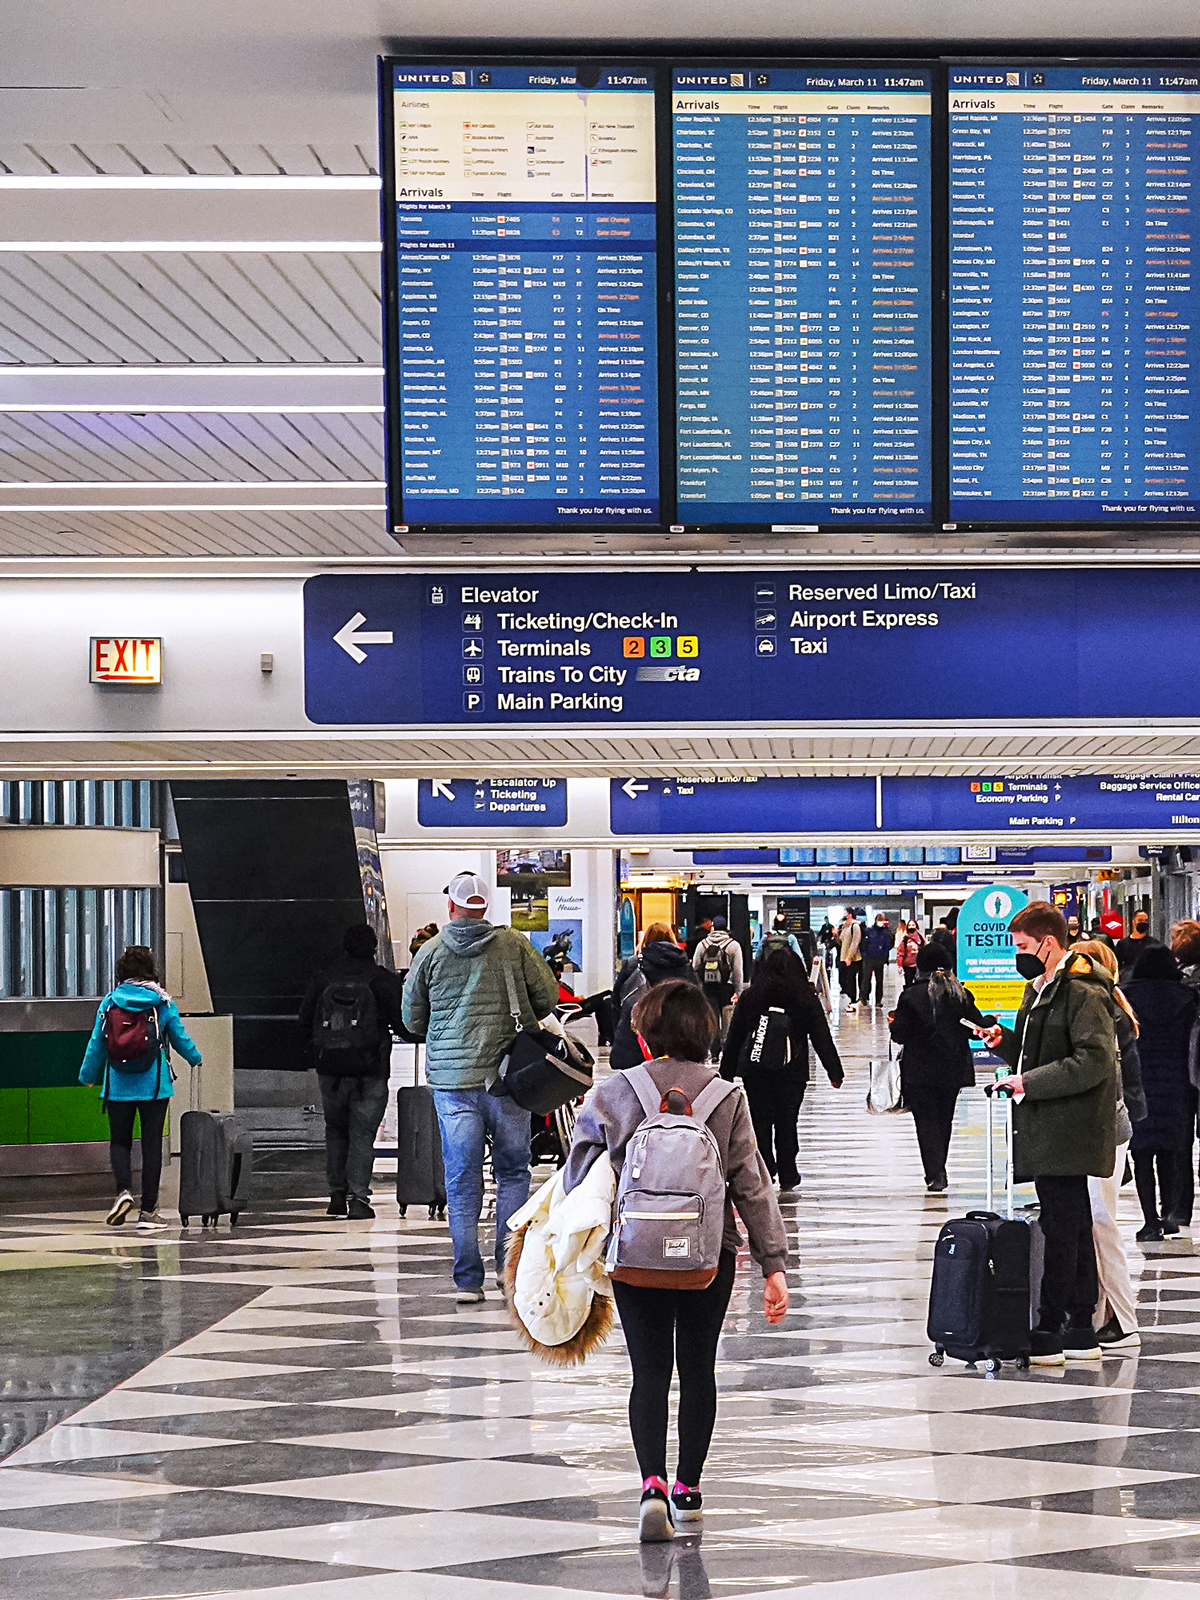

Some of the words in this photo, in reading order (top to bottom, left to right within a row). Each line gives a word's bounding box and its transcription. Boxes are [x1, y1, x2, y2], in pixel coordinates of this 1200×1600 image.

[529, 76, 559, 85] Friday,
[560, 76, 577, 84] Mar
[607, 76, 647, 85] 11:47am
[677, 76, 728, 84] UNITED
[806, 78, 836, 87] Friday,
[837, 78, 864, 86] March
[867, 78, 877, 86] 11
[884, 78, 924, 87] 11:47am
[953, 75, 1004, 84] UNITED
[1081, 77, 1111, 86] Friday,
[1112, 77, 1139, 85] March
[1142, 77, 1151, 85] 11
[1158, 77, 1198, 86] 11:47am
[676, 100, 720, 110] Arrivals
[952, 99, 996, 109] Arrivals
[399, 188, 444, 198] Arrivals
[557, 506, 577, 514] Thank
[605, 506, 625, 515] flying
[627, 506, 642, 514] with
[878, 507, 898, 516] flying
[1149, 505, 1169, 513] flying
[461, 587, 539, 603] Elevator
[789, 584, 878, 601] Reserved
[884, 583, 976, 600] Limo/Taxi
[497, 612, 678, 632] Ticketing/Check-In
[790, 610, 857, 630] Airport
[862, 610, 939, 630] Express
[497, 639, 591, 656] Terminals
[790, 637, 828, 654] Taxi
[95, 639, 155, 672] EXIT
[497, 666, 556, 684] Trains
[560, 666, 584, 683] To
[589, 665, 627, 686] City
[665, 665, 700, 682] cta
[497, 693, 544, 710] Main
[550, 692, 623, 713] Parking
[490, 778, 538, 787] Escalator
[542, 778, 557, 788] Up
[1008, 783, 1048, 791] Terminals
[1100, 782, 1138, 791] Baggage
[1139, 782, 1172, 790] Service
[1173, 781, 1200, 790] Office
[490, 789, 537, 801] Ticketing
[676, 786, 694, 795] Taxi
[975, 794, 1015, 804] Economy
[1016, 794, 1049, 804] Parking
[1155, 793, 1184, 801] Rental
[1184, 793, 1200, 801] Car
[489, 801, 547, 813] Departures
[1009, 817, 1030, 825] Main
[1031, 816, 1064, 826] Parking
[1171, 815, 1200, 824] Hilton
[973, 922, 1006, 932] COVID
[965, 934, 1013, 947] TESTI
